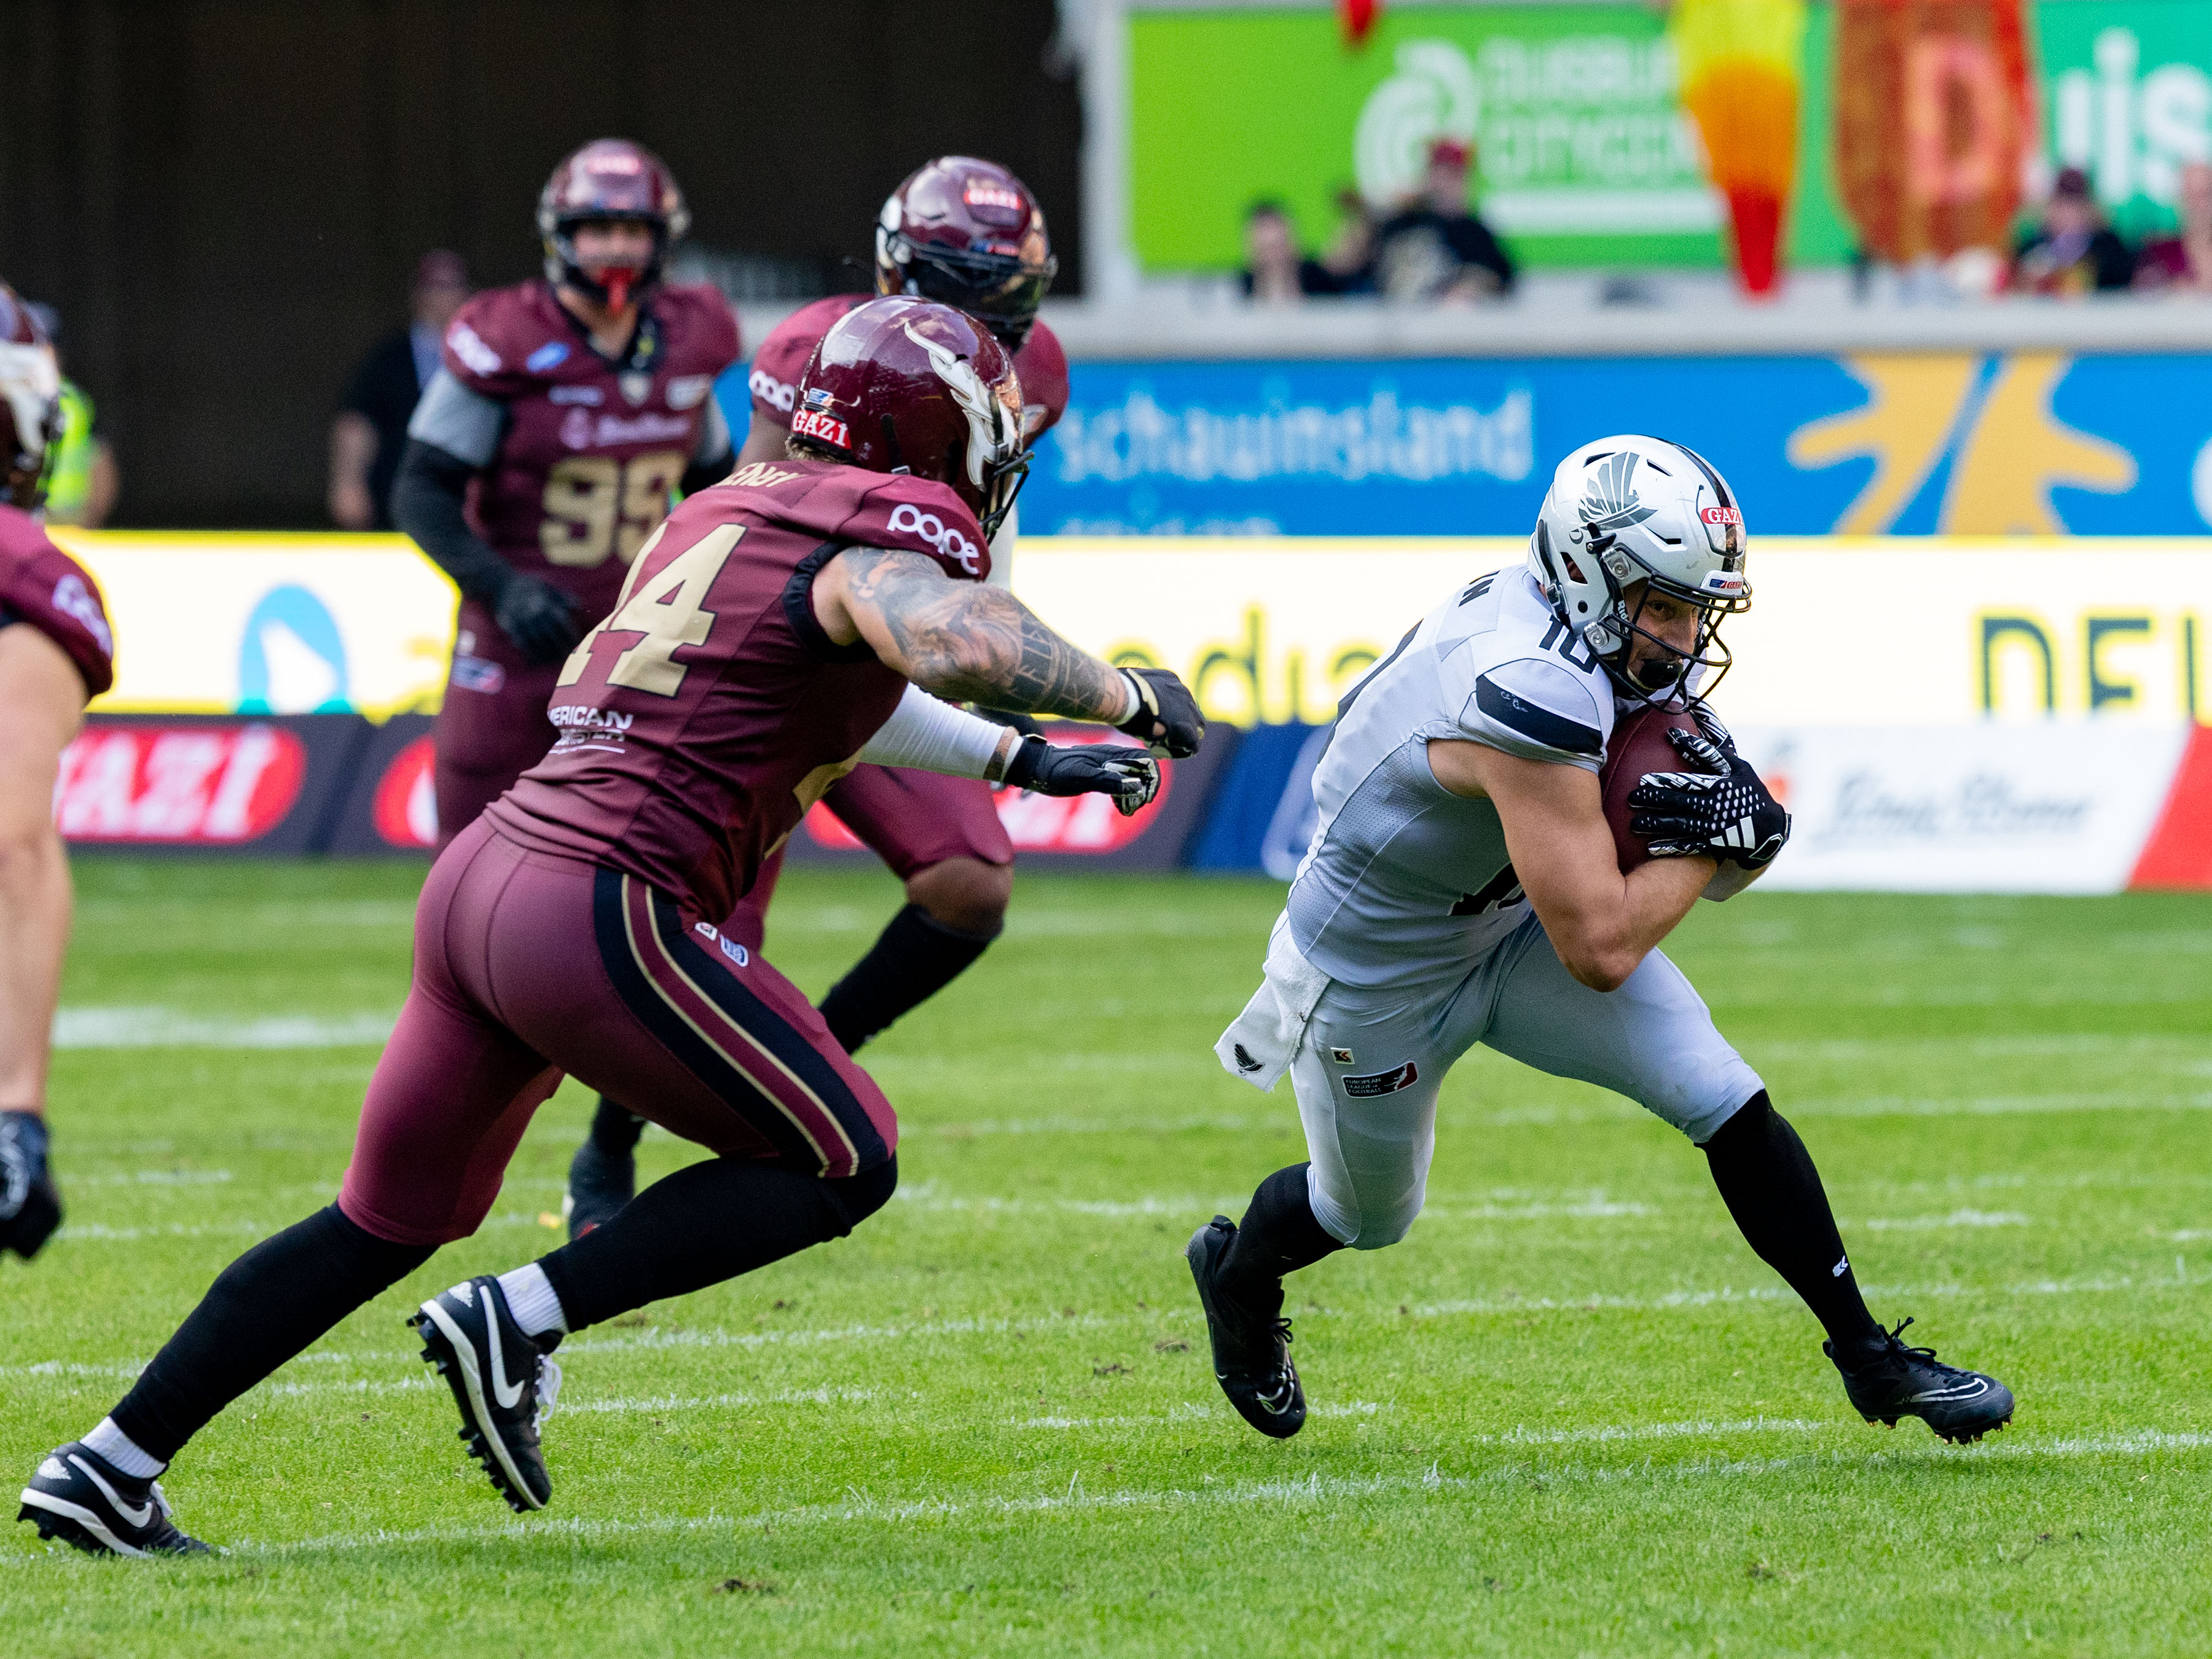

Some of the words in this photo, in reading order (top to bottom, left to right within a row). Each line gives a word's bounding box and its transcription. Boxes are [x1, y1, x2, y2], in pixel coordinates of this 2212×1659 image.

[793, 410, 848, 447] GAZI
[539, 452, 687, 568] 99
[1538, 614, 1598, 675] 10
[547, 705, 633, 730] ERICAN
[53, 731, 275, 837] AZI
